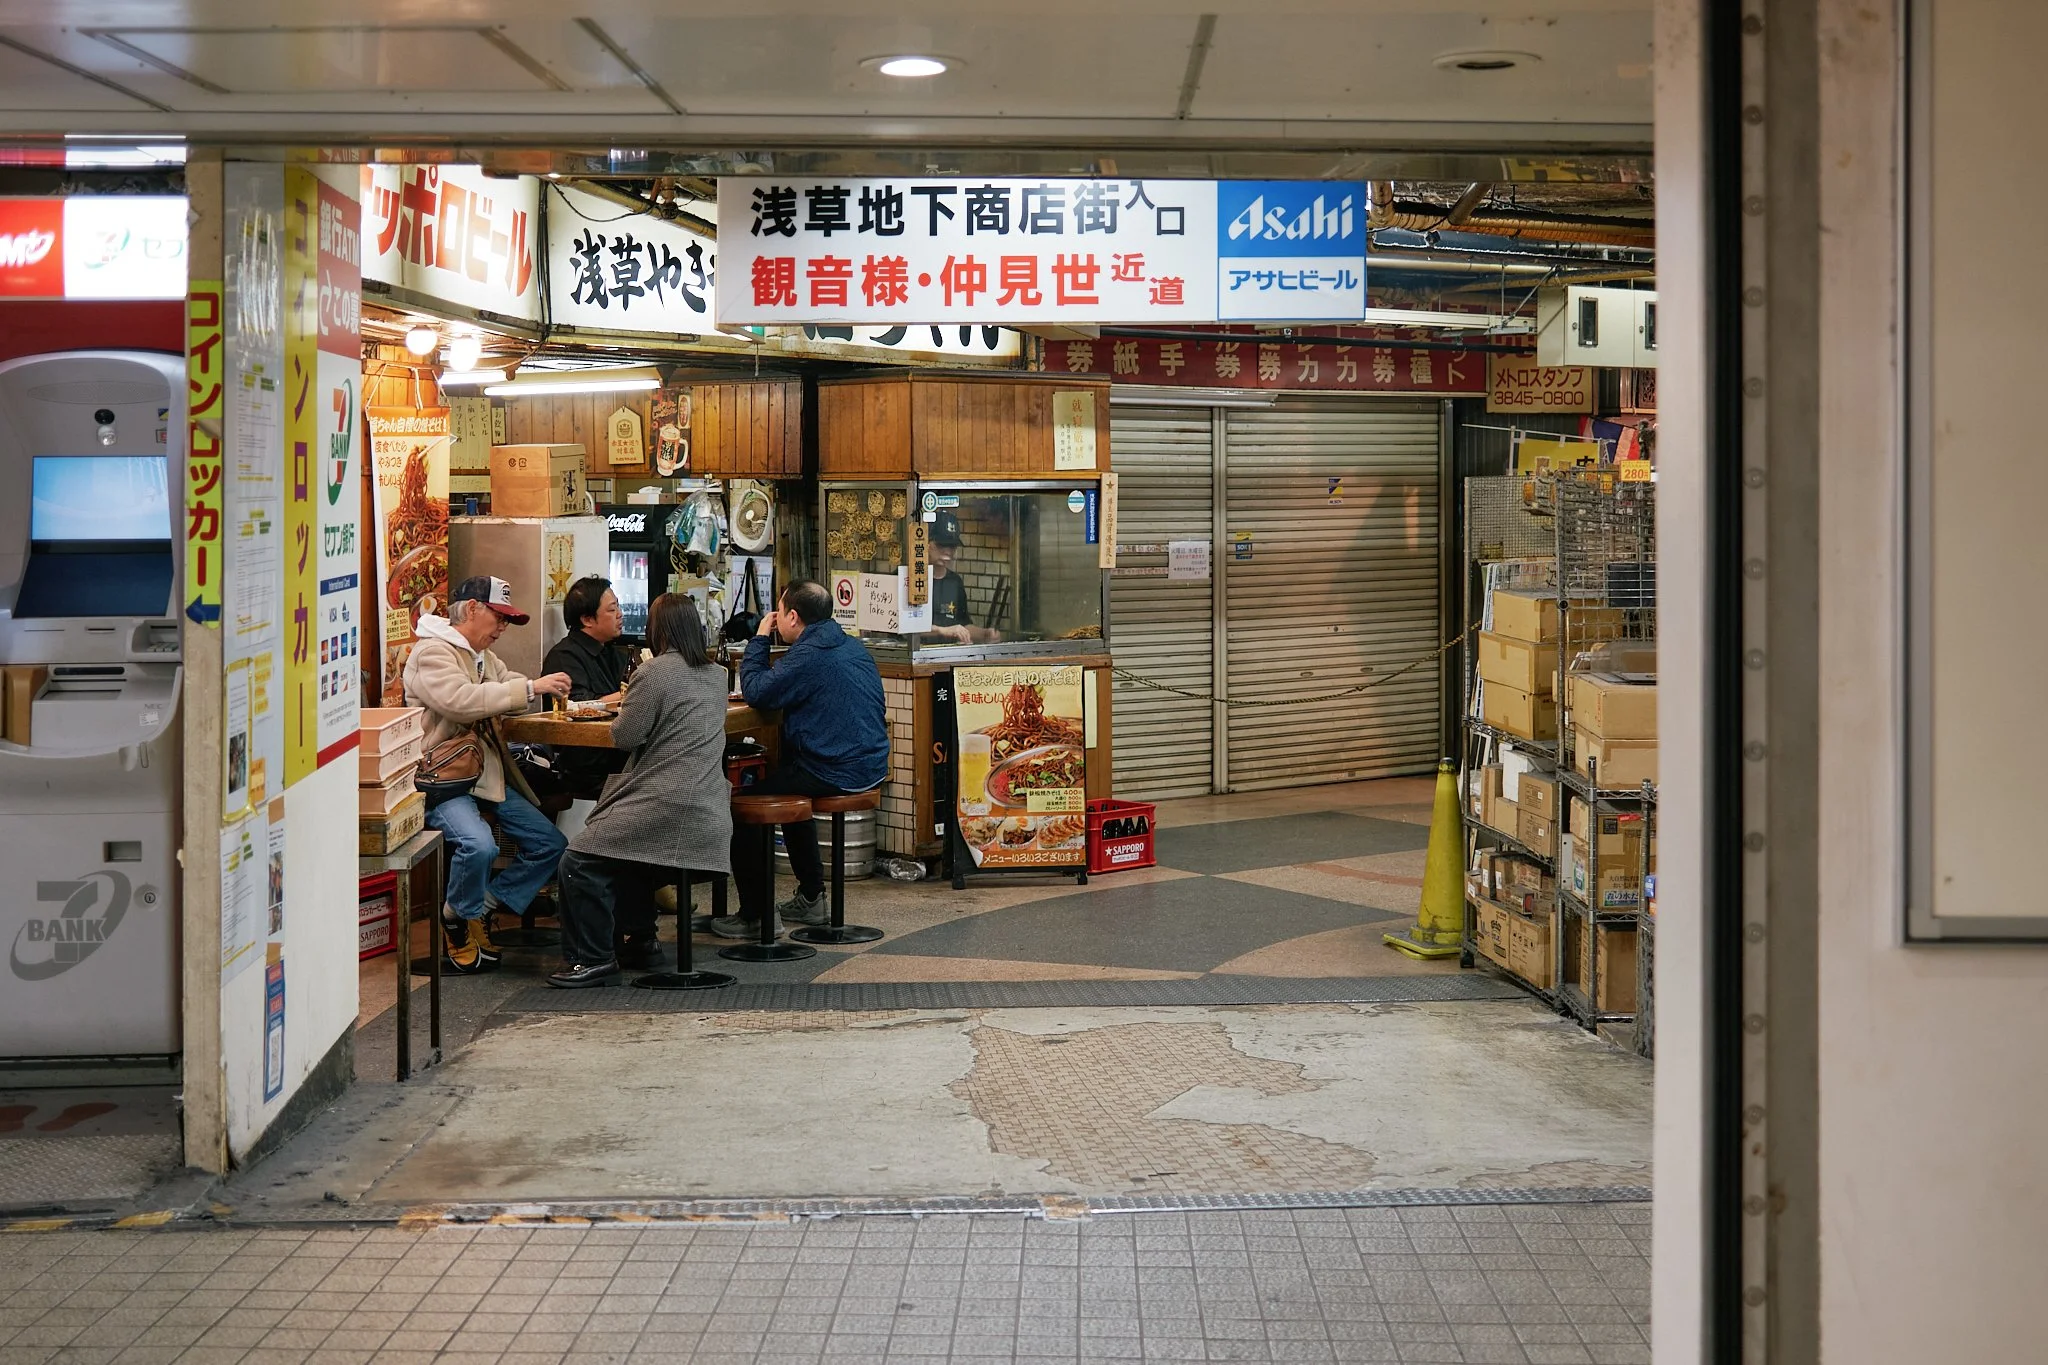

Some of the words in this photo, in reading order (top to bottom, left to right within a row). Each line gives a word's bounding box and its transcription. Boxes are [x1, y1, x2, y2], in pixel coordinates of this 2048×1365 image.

[751, 180, 1185, 238] 浅草地下商店街入口
[1228, 194, 1353, 241] Asahi
[320, 199, 360, 268] 銀行ATM
[570, 228, 716, 313] 浅草やき
[751, 252, 1185, 307] 観音様・仲見世近道
[1229, 270, 1357, 291] アサヒビール
[1495, 368, 1584, 388] メトロスタンプ
[1494, 391, 1584, 405] 3845-0800
[190, 291, 222, 588] コインロッカー
[324, 522, 355, 558] セブン銀行
[914, 544, 925, 592] 営業中
[958, 670, 1081, 688] 福ちゃん自慢の焼そば!
[984, 853, 1080, 864] メニューいろいろございます
[1112, 842, 1144, 855] SAPPORO
[28, 919, 106, 941] BANK
[360, 925, 389, 943] SAPPORO
